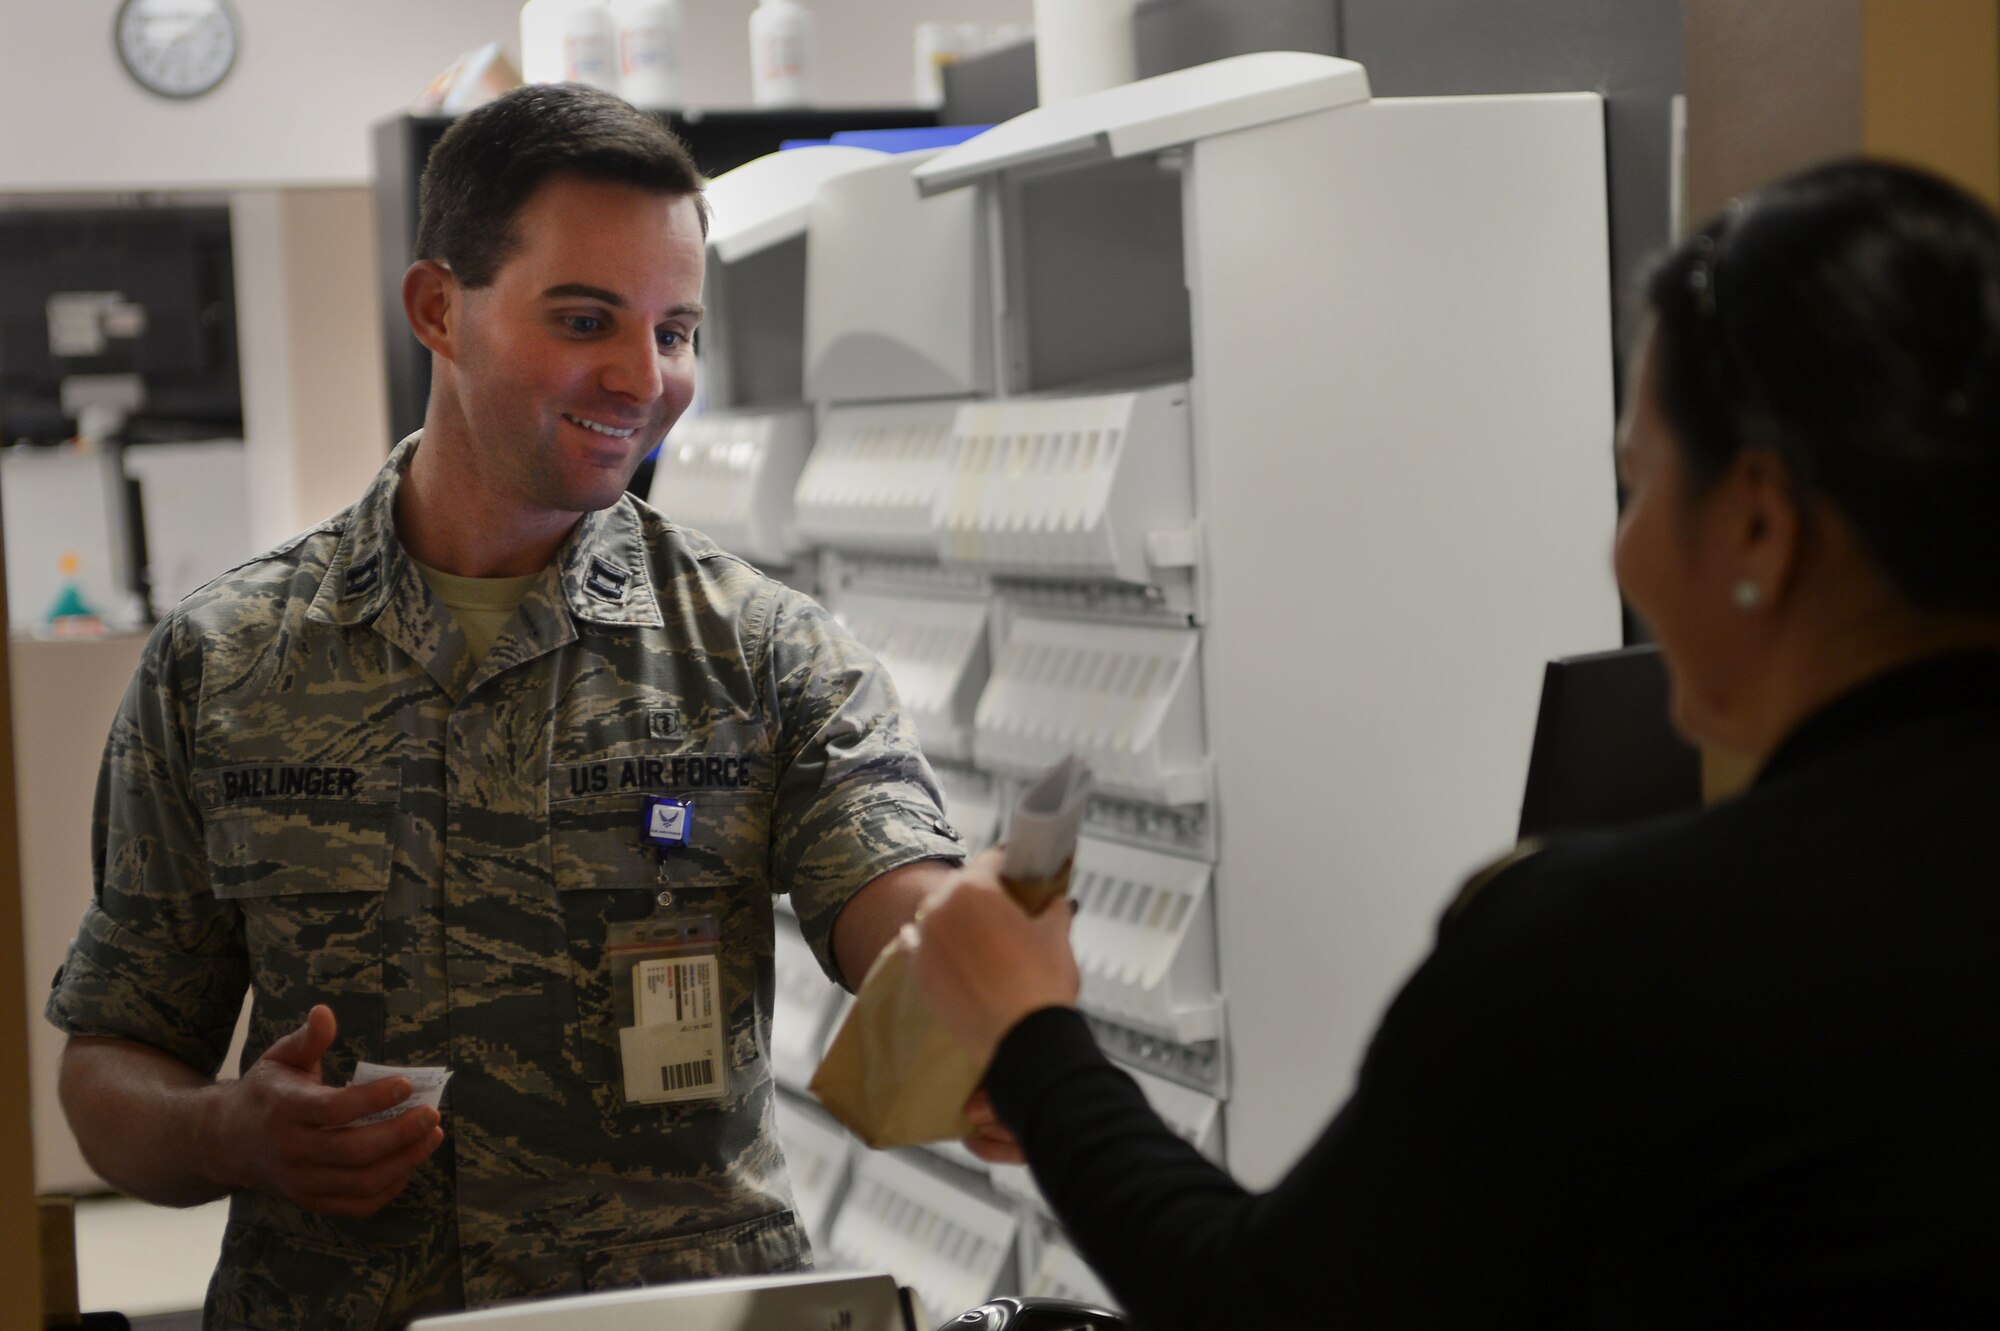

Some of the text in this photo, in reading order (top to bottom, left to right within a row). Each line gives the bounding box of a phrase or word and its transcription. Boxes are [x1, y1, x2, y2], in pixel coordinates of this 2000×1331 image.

[223, 767, 357, 800] BALLINGER
[620, 756, 664, 788] AIR
[672, 757, 751, 787] FORCE
